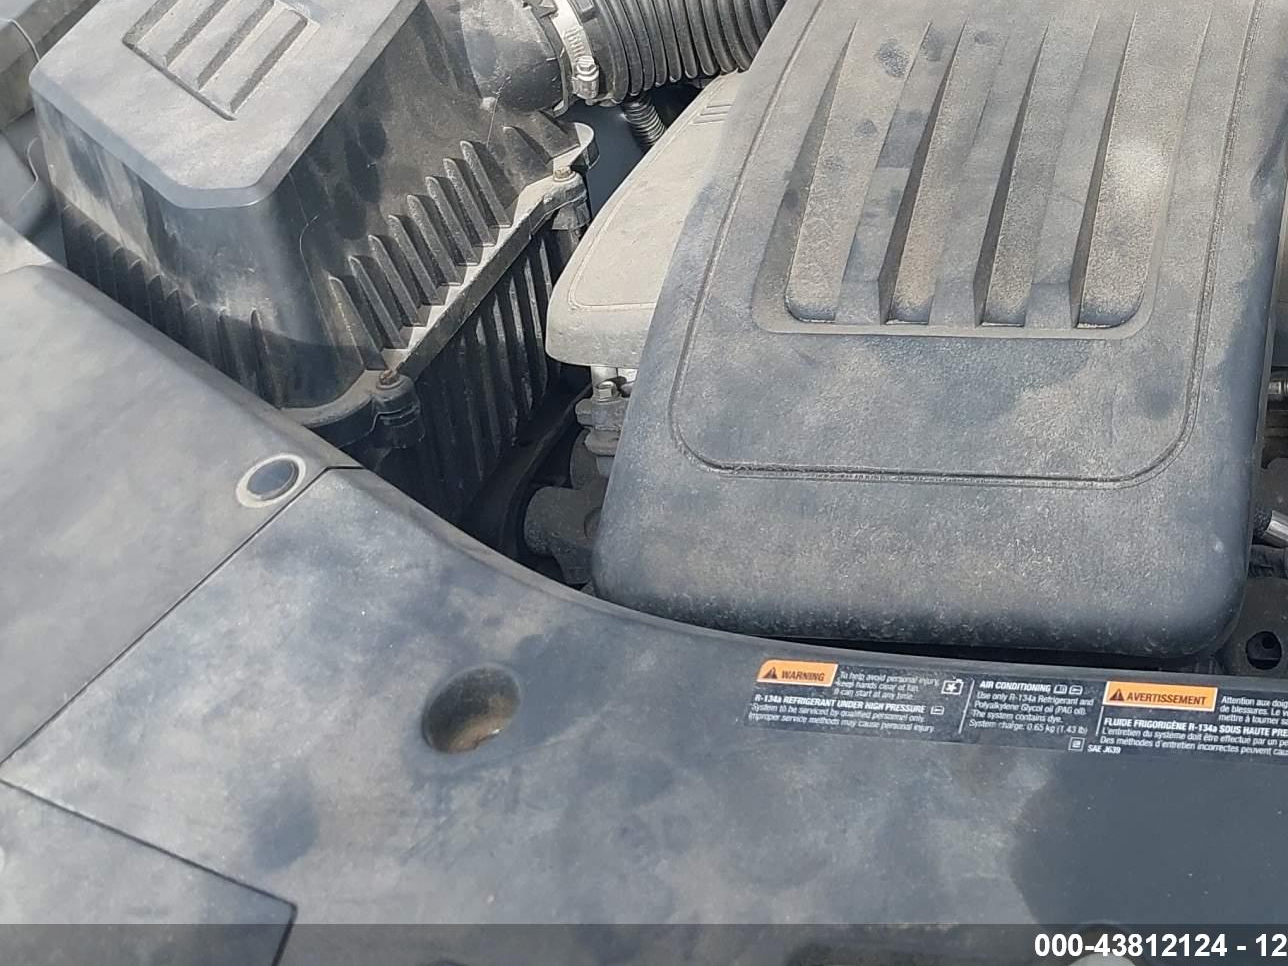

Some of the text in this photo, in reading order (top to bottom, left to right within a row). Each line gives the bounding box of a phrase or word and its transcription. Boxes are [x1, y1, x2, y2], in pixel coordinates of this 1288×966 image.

[781, 670, 825, 681] WARNING
[839, 671, 847, 680] To
[849, 673, 865, 682] help
[866, 674, 885, 682] avoid
[887, 676, 917, 685] personal
[855, 682, 876, 690] hands
[995, 682, 1051, 692] CONDITIONING
[855, 690, 871, 698] start
[882, 692, 896, 700] any
[992, 693, 1007, 701] only
[1009, 694, 1036, 702] R-134a
[1038, 696, 1078, 707] Refrigerant
[1127, 692, 1207, 705] AVERTISSEMENT
[1221, 696, 1255, 705] Attention
[1256, 698, 1270, 706] aux
[755, 694, 926, 713] R-134a REFRIGERANT UNDER HIGH PRESSURE
[974, 701, 1019, 711] Polyalkylene
[1021, 704, 1043, 713] Glycol
[1055, 706, 1072, 715] (PAG
[1073, 707, 1086, 715] oil).
[751, 704, 777, 714] System
[779, 704, 786, 712] to
[798, 706, 829, 715] serviced
[830, 708, 840, 718] by
[841, 710, 870, 720] qualified
[872, 711, 907, 722] personnel
[987, 711, 1013, 720] system
[1015, 713, 1045, 721] contains
[1047, 714, 1063, 723] dye.
[1220, 705, 1230, 713] de
[1231, 706, 1268, 716] blessures.
[1271, 708, 1281, 716] Le
[749, 712, 935, 733] Improper service methods may cause personal injury.
[1218, 714, 1242, 722] mettre
[1245, 714, 1250, 722] à
[1252, 716, 1279, 725] tourner
[969, 719, 1088, 734] System charge: 0.65 kg (1.43 lb)
[1104, 717, 1132, 727] FLUIDE
[1134, 718, 1186, 730] FRIGORIGÈNE
[1188, 723, 1217, 732] R-134a
[1219, 725, 1242, 733] SOUS
[1243, 726, 1269, 736] HAUTE
[1103, 727, 1142, 736] L'entretien
[1143, 729, 1153, 737] du
[1187, 732, 1202, 740] doit
[1203, 733, 1217, 742] être
[1253, 737, 1265, 746] par
[1267, 738, 1277, 746] un
[1087, 745, 1121, 754] SAE J639
[1100, 736, 1115, 744] Des
[1116, 737, 1153, 746] méthodes
[1155, 739, 1195, 749] d'entretien
[1197, 741, 1239, 752] incorrectes
[1241, 746, 1271, 756] peuvent
